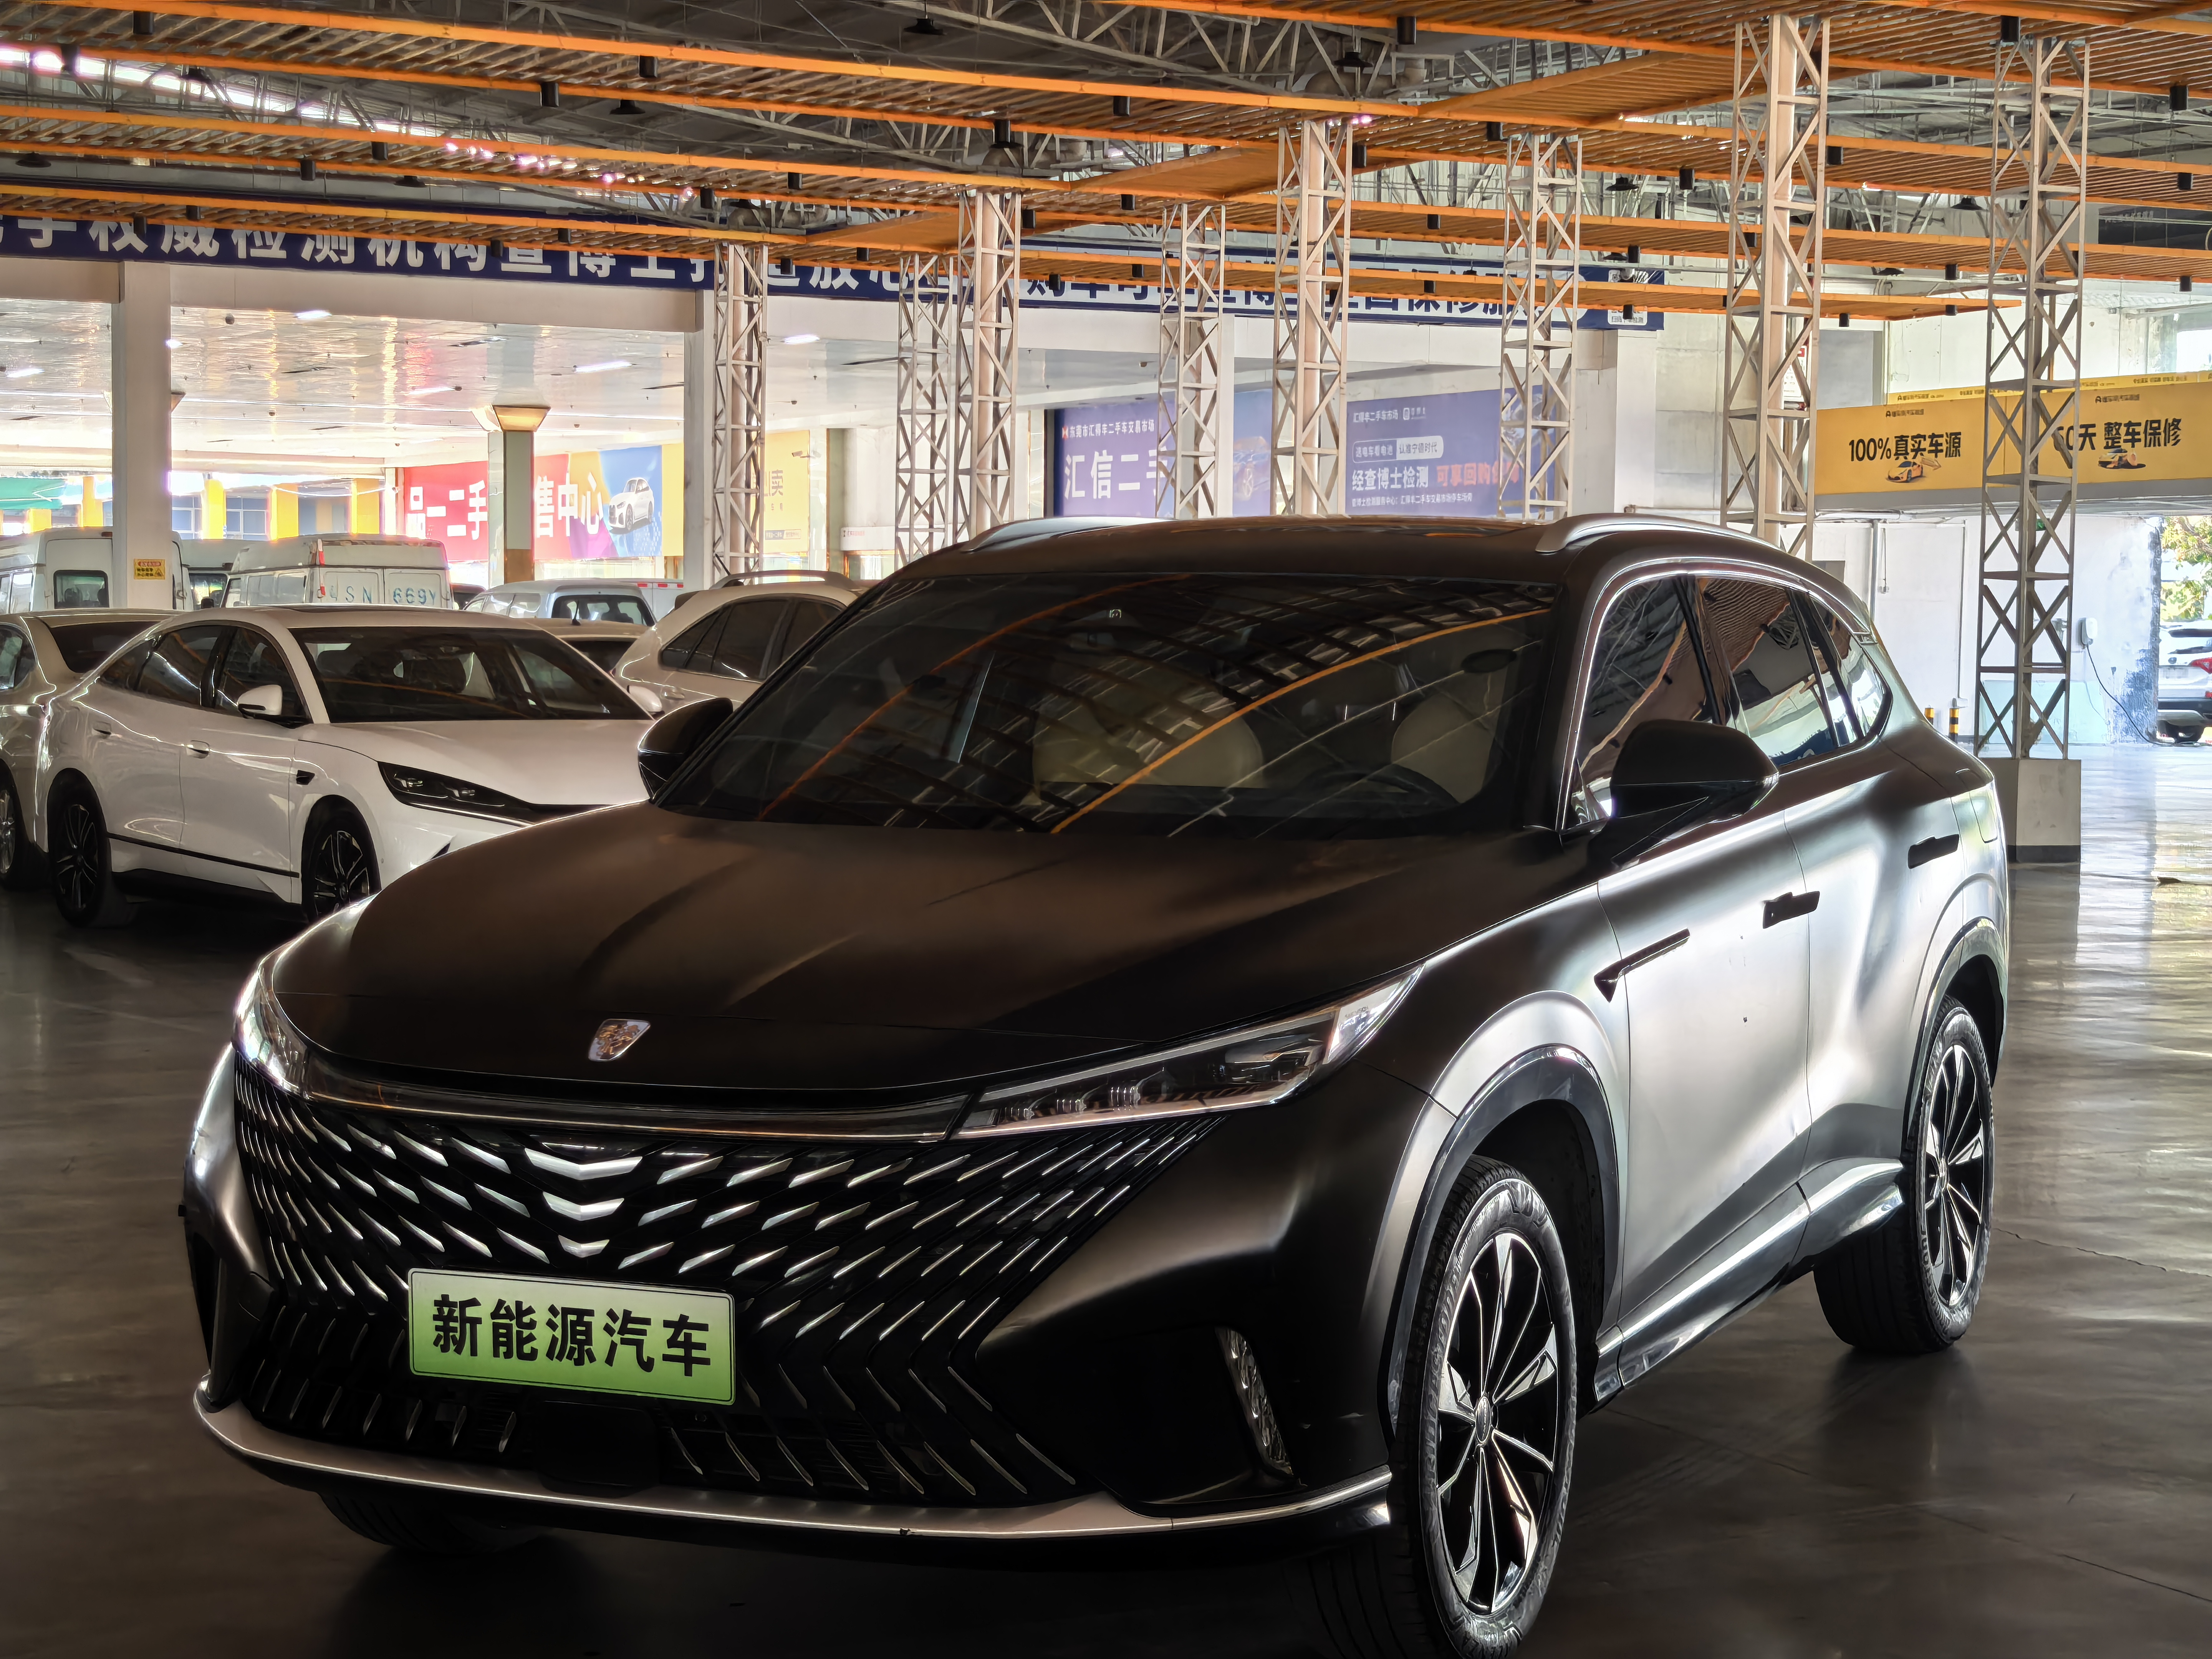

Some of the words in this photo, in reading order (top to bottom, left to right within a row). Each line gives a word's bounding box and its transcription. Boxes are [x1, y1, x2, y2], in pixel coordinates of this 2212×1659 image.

[2103, 417, 2182, 450] 整车保修
[1352, 465, 1429, 491] 经查博士检测
[432, 1293, 711, 1378] 新能源汽车
